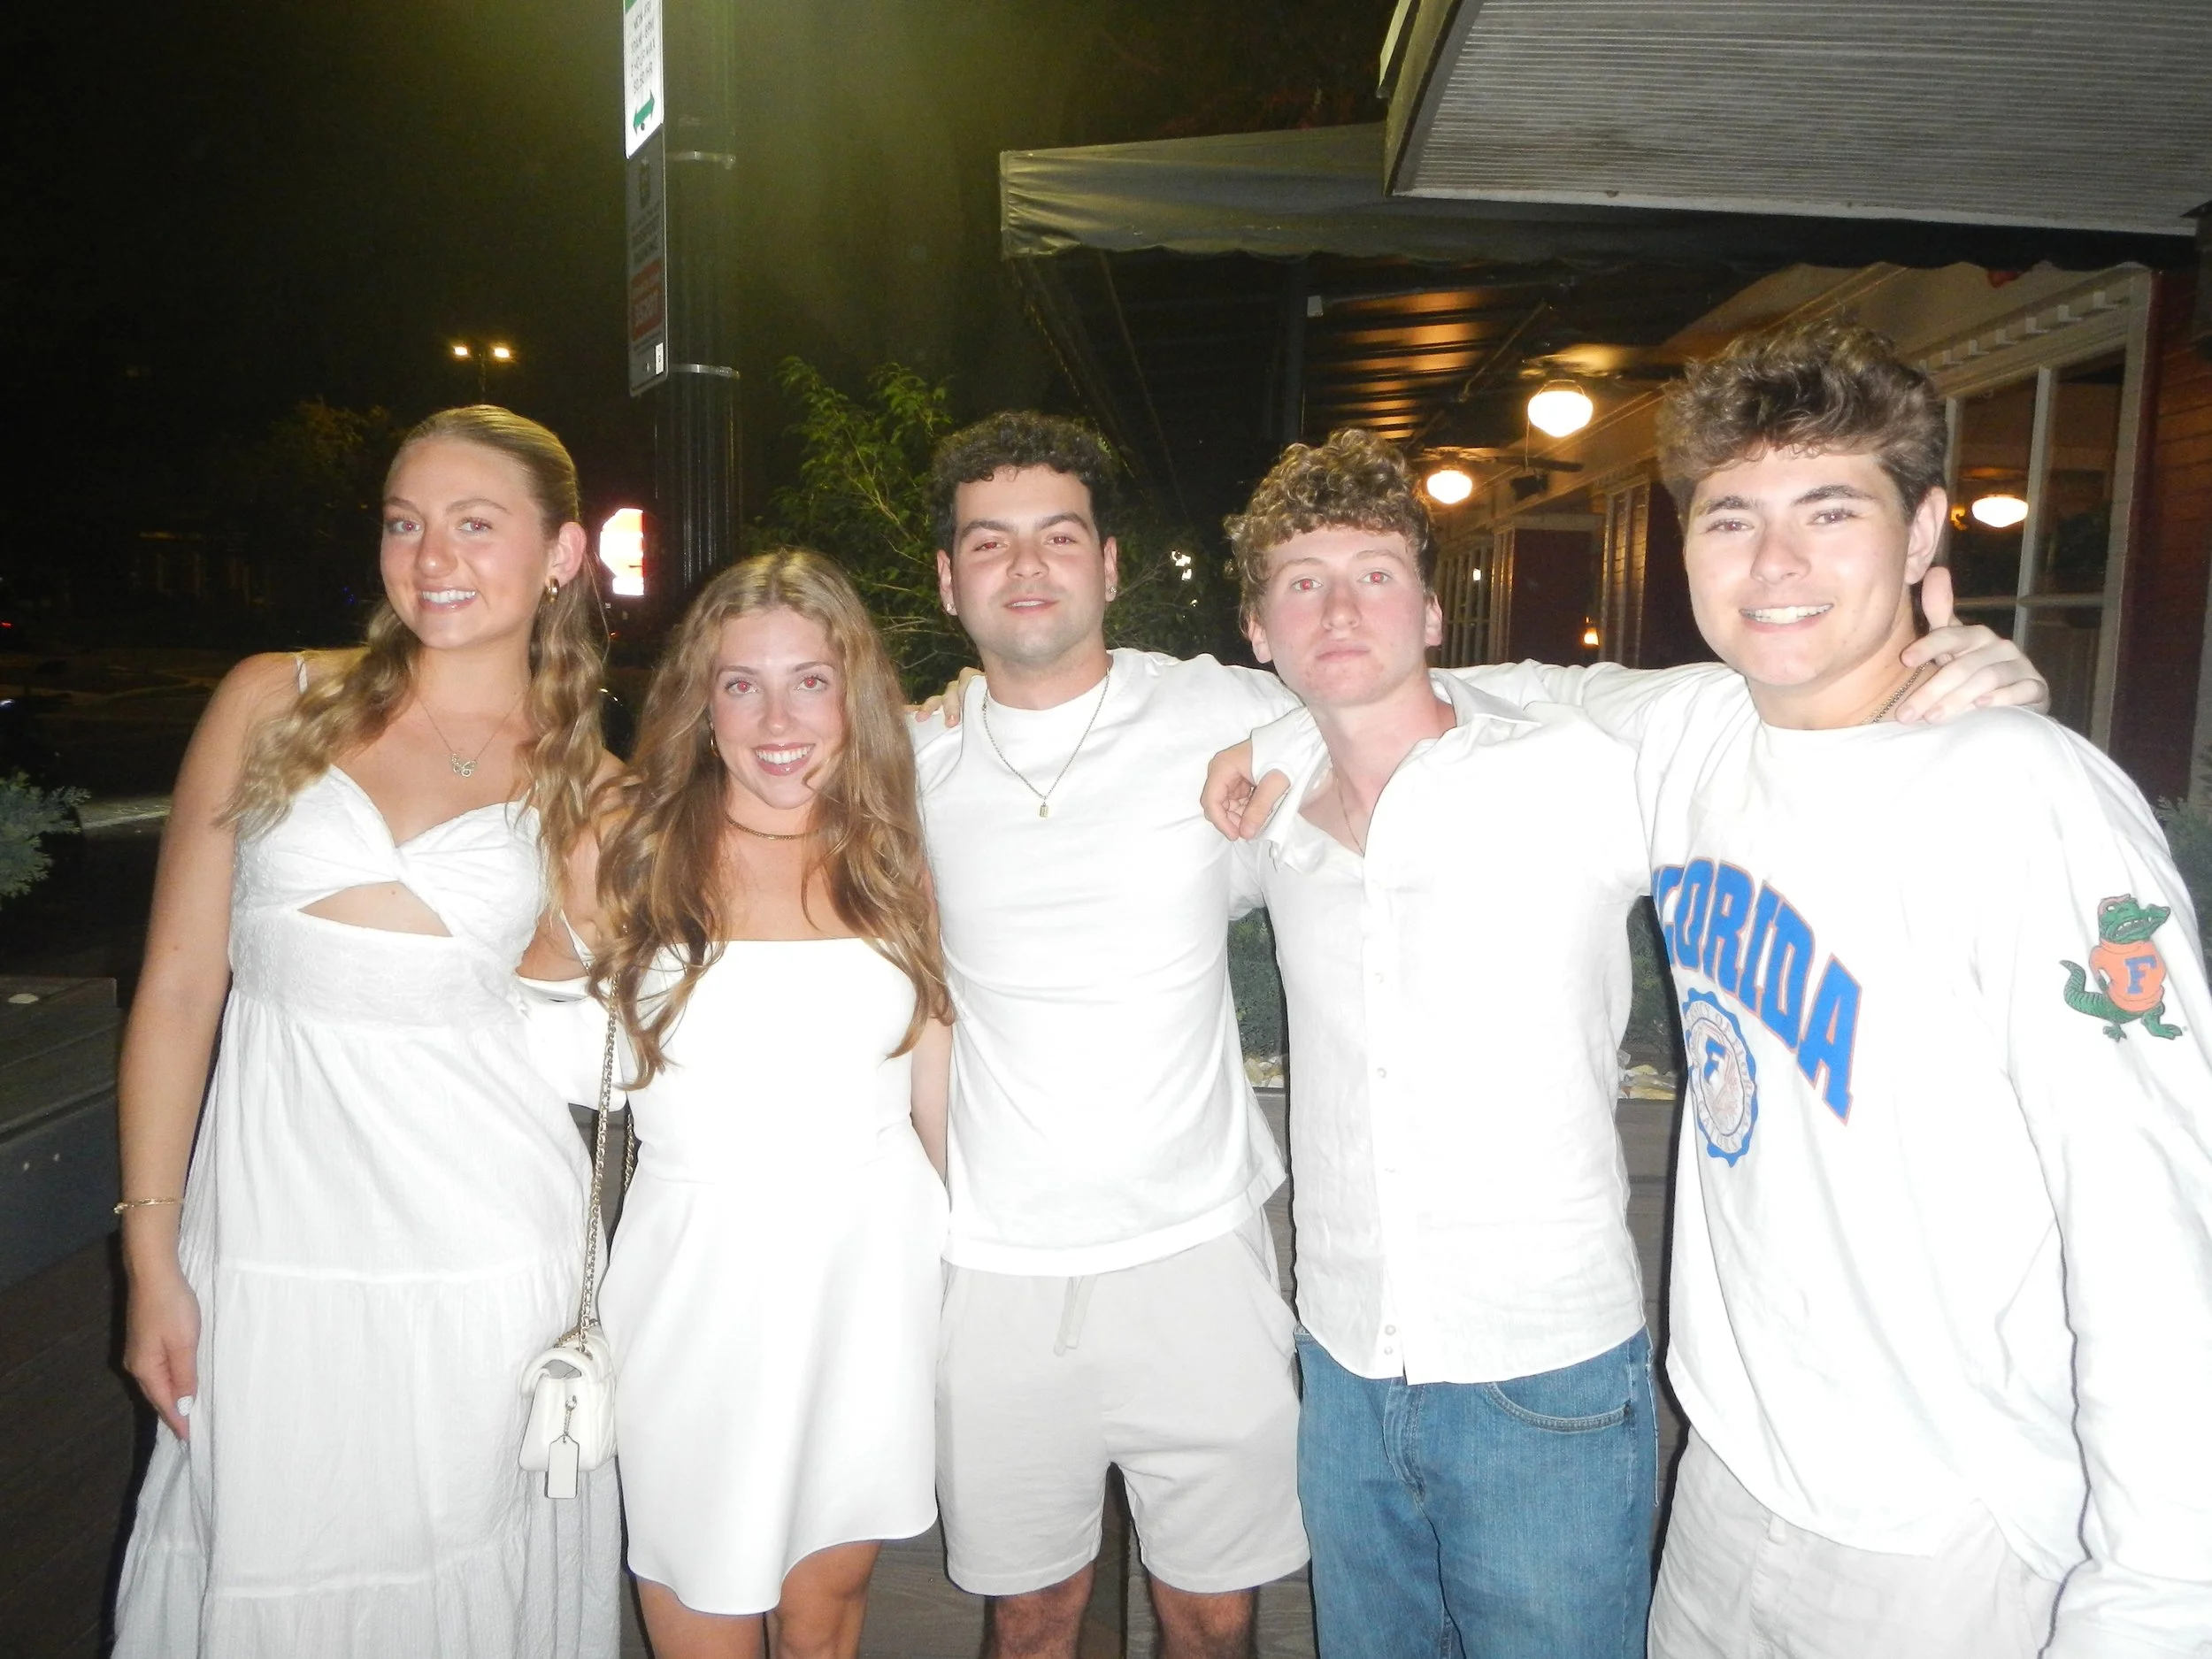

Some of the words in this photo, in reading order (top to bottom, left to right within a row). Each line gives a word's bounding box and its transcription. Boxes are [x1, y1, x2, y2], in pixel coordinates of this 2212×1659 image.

[1652, 857, 1863, 1126] LORIDA
[2125, 956, 2157, 995] F
[1704, 1035, 1727, 1080] F
